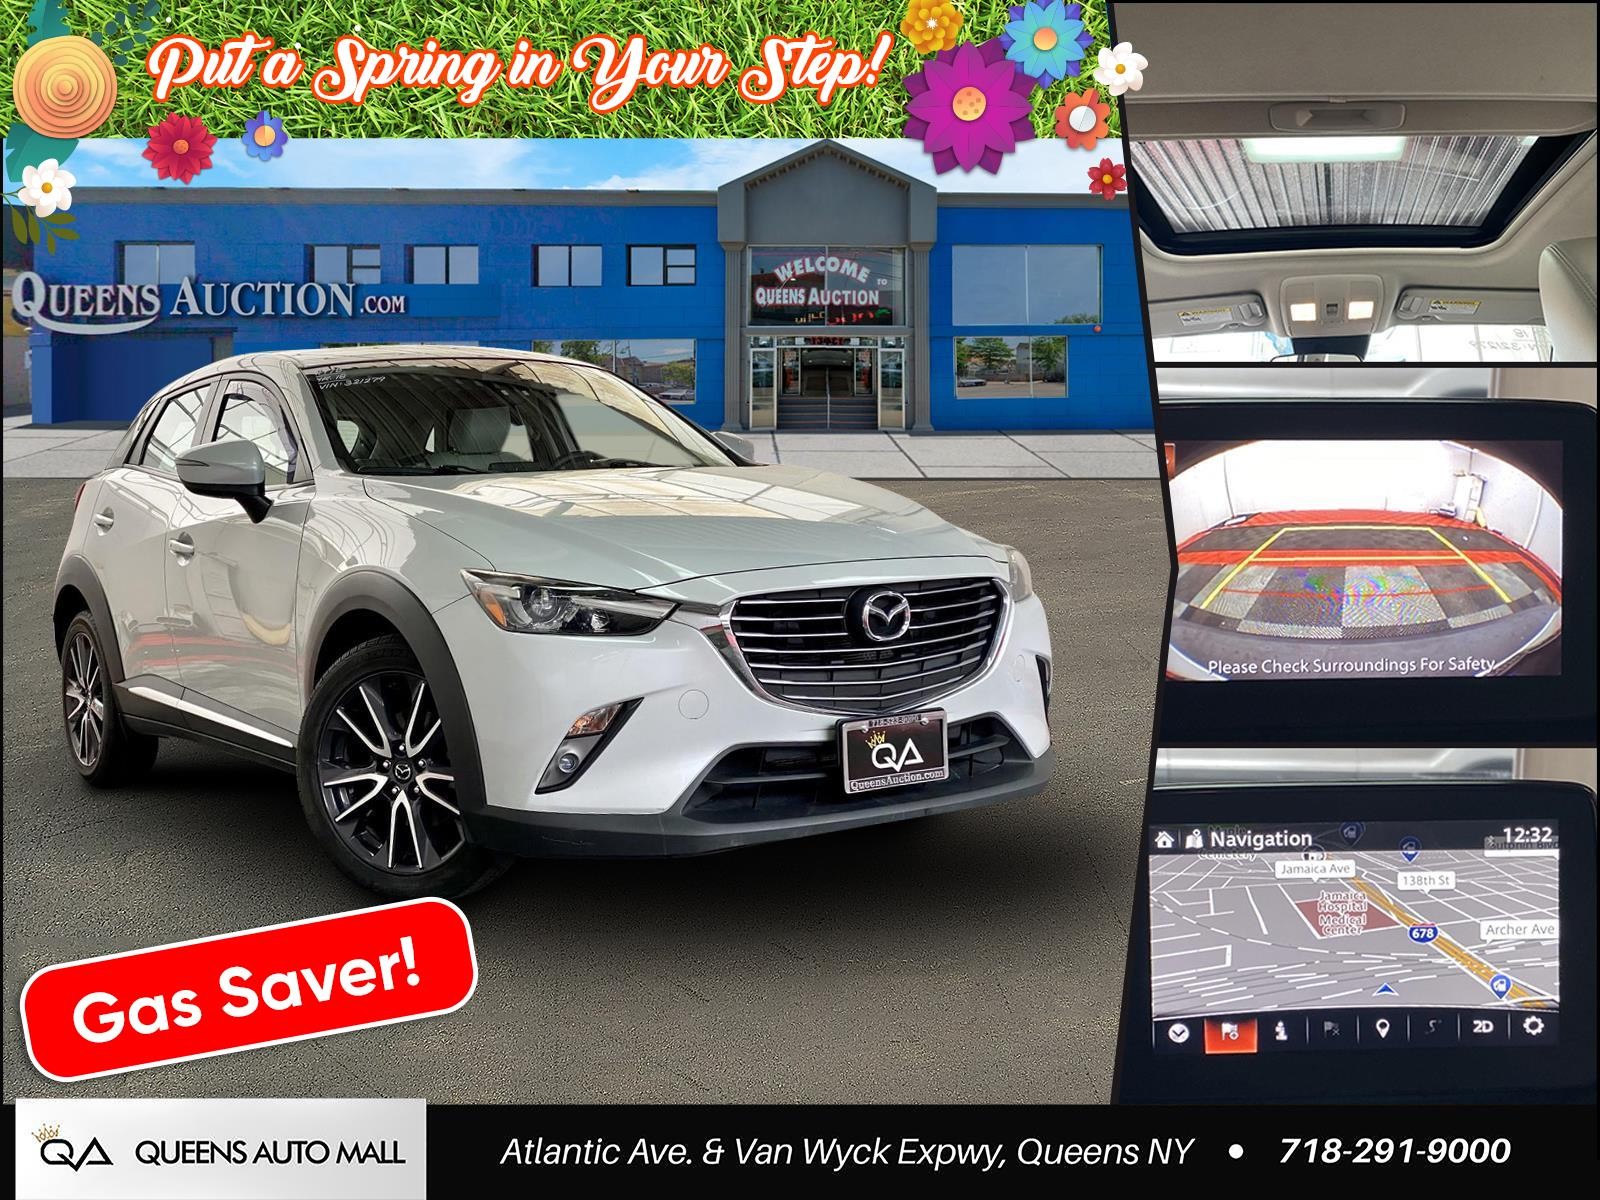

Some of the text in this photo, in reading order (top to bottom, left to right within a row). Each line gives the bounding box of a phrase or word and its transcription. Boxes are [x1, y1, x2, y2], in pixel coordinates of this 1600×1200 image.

[774, 256, 870, 284] WELCOME
[12, 271, 161, 335] QUEENS
[170, 276, 355, 316] AUCTION
[755, 287, 880, 306] QUEENS AUCTION
[1208, 656, 1496, 675] Please Check Surroundings For Safety
[871, 738, 924, 773] QA
[850, 769, 944, 791] QueensAuction.com
[1210, 829, 1313, 851] Navigation
[1503, 826, 1553, 843] 12:32
[1281, 863, 1350, 875] Jamaica Ave
[1402, 874, 1450, 886] 138th St
[1319, 890, 1367, 900] Jamaica
[1318, 902, 1368, 914] Hospital
[1319, 914, 1367, 925] Medical
[1323, 926, 1362, 935] Center
[1411, 928, 1434, 939] 678
[1485, 923, 1555, 936] Archer Ave
[1473, 1020, 1494, 1034] 2D
